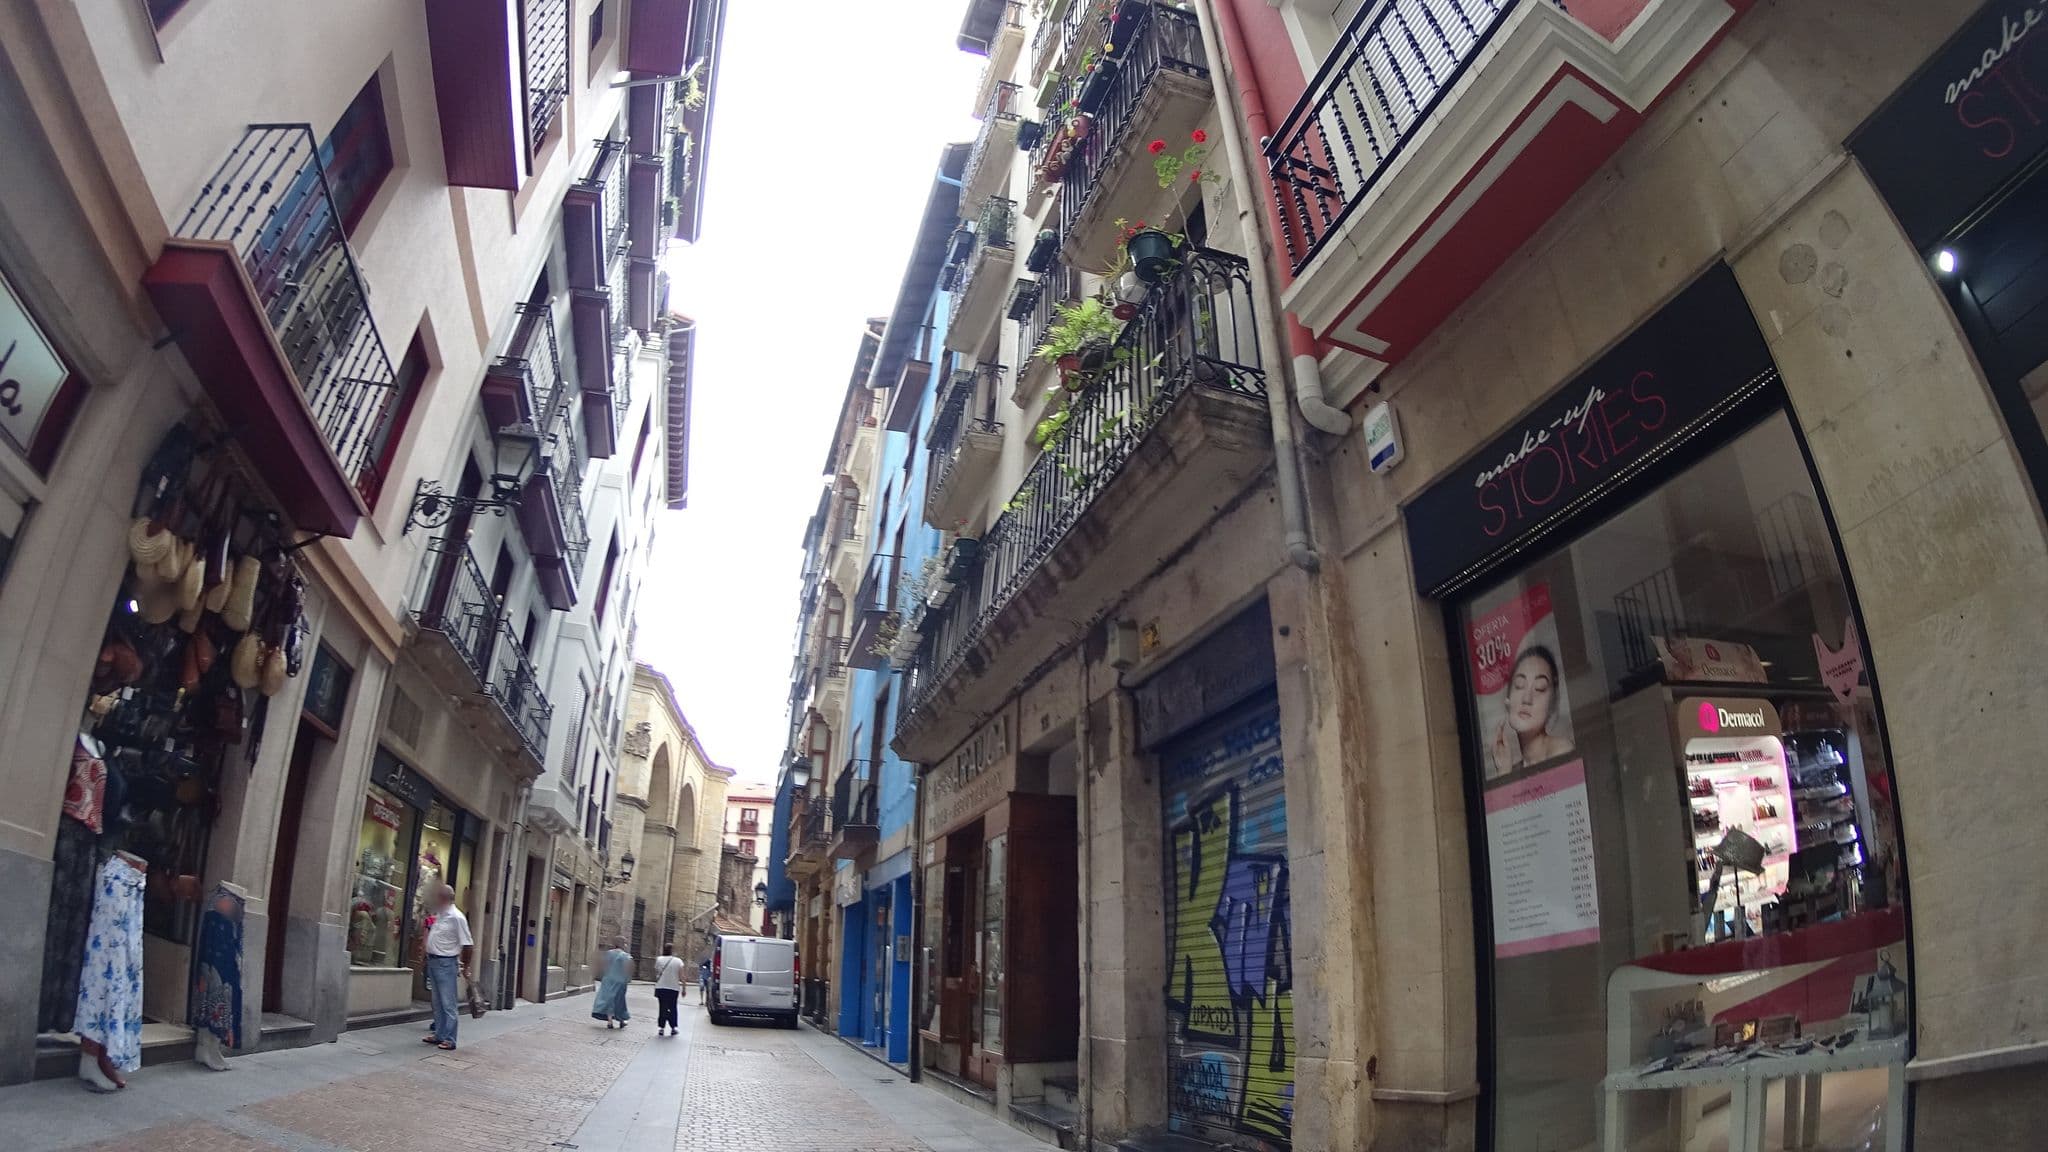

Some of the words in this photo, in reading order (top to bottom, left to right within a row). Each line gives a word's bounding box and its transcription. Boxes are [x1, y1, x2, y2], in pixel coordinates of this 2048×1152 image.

[1475, 386, 1606, 488] make-up
[1479, 371, 1667, 536] STORIES
[1473, 615, 1510, 640] OFERTA
[1476, 632, 1511, 670] 30%
[1718, 707, 1764, 728] Dermacol
